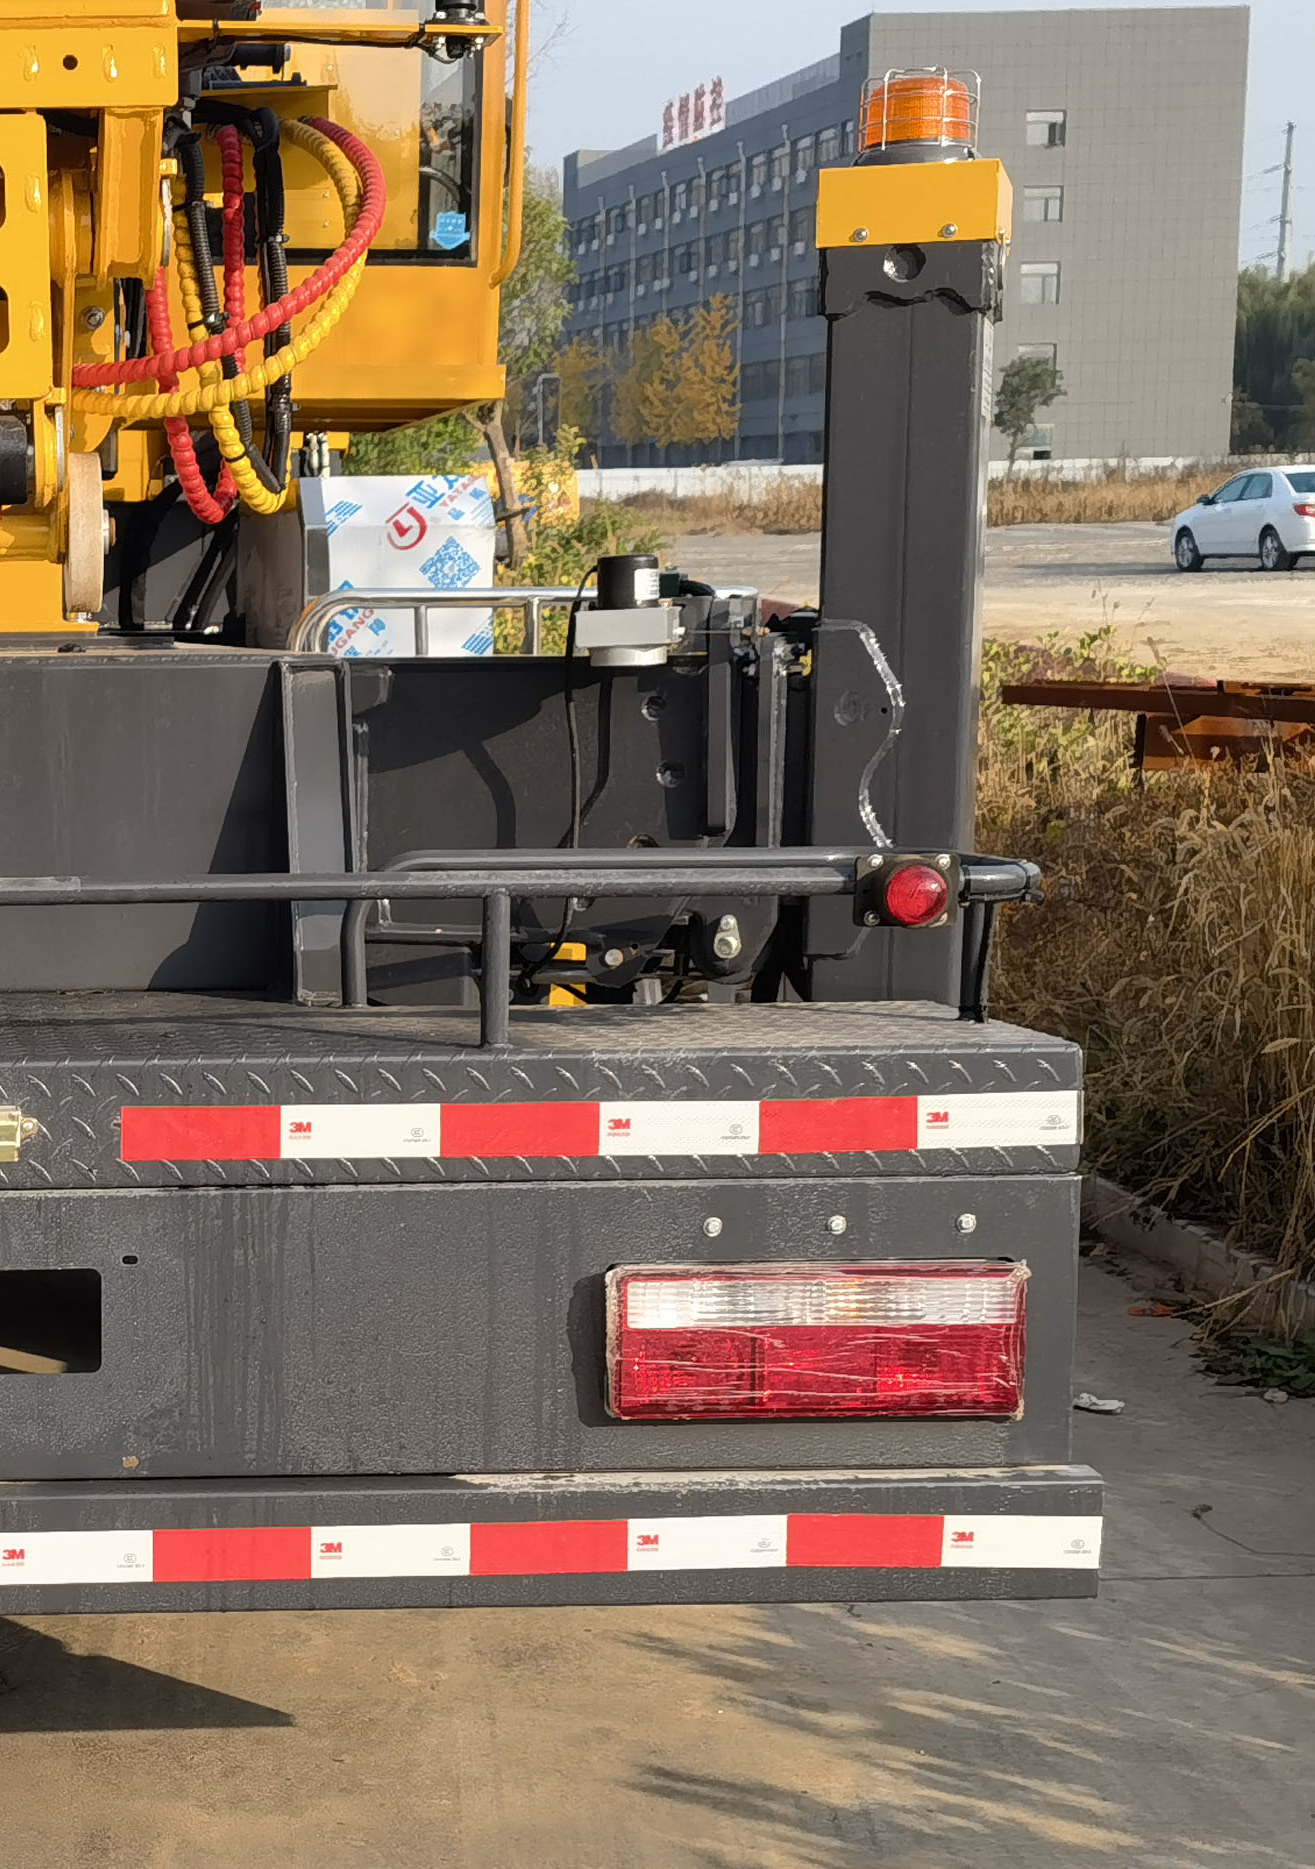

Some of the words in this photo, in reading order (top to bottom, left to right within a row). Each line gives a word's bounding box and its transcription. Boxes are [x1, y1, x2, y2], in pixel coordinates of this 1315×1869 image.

[926, 1111, 949, 1123] 3M
[290, 1122, 313, 1134] 3M
[609, 1118, 631, 1130] 3M
[636, 1535, 659, 1546] 3M
[950, 1531, 974, 1542] 3M
[321, 1542, 343, 1553] 3M
[3, 1549, 26, 1560] 3M
